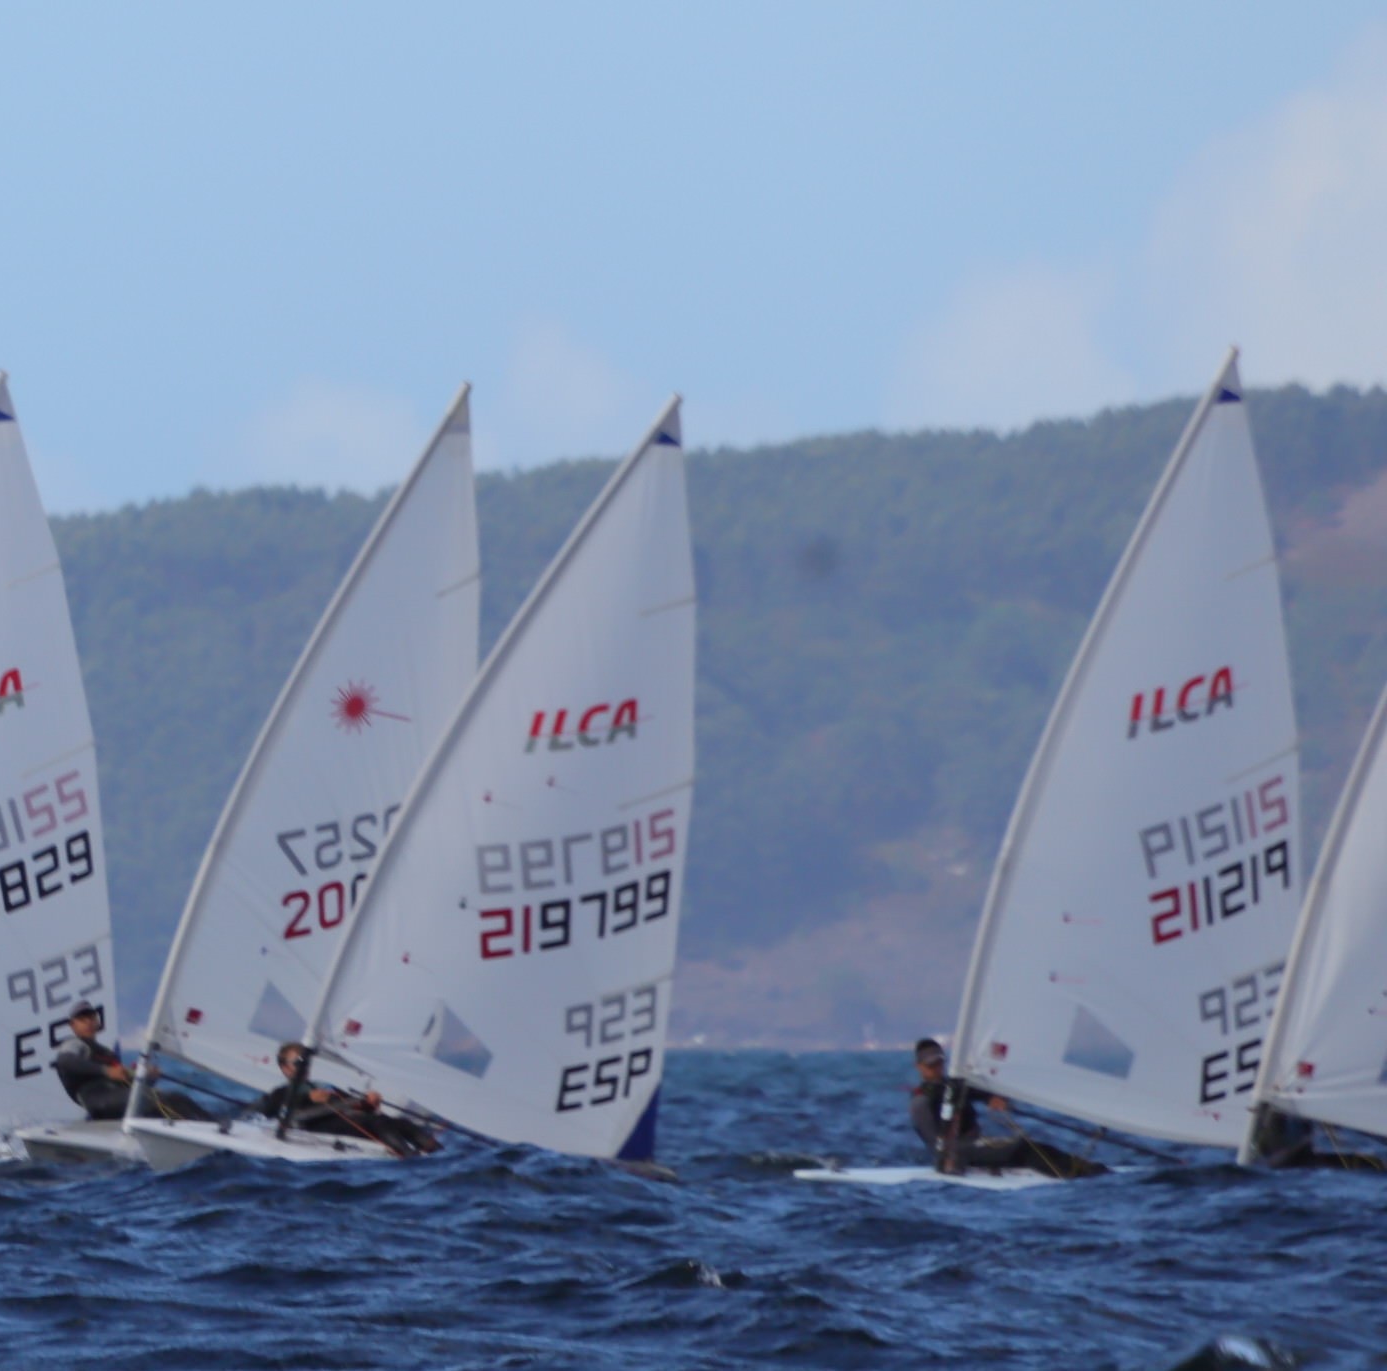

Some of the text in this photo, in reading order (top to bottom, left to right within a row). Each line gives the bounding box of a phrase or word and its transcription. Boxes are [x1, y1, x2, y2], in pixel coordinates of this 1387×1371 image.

[524, 697, 639, 754] ILCA
[1127, 665, 1234, 740] ILCA
[479, 869, 671, 961] 219799
[1148, 839, 1290, 946] 211219
[555, 1046, 653, 1113] ESP
[1199, 1038, 1262, 1106] ES
